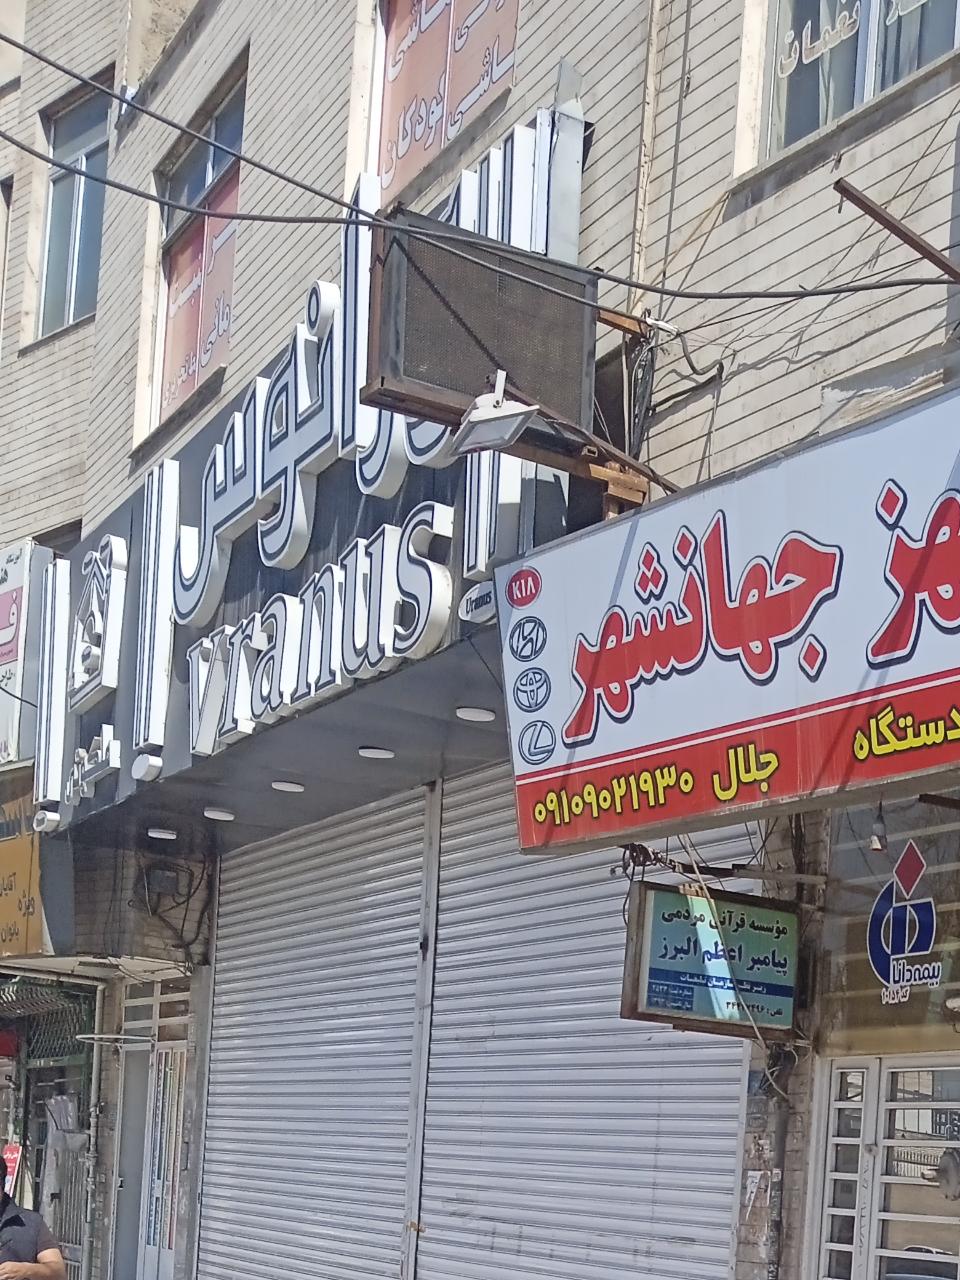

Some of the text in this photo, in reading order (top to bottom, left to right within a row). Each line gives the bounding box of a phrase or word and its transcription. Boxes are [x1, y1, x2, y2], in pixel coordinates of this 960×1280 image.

[512, 578, 536, 600] KIA
[563, 508, 842, 750] جهانشهر
[534, 763, 694, 827] ۰۹۱۰۹۰۲۱۹۳۰
[712, 744, 779, 801] جلال
[661, 909, 706, 927] مردمی
[658, 936, 788, 977] پیامبر اعظم البرز
